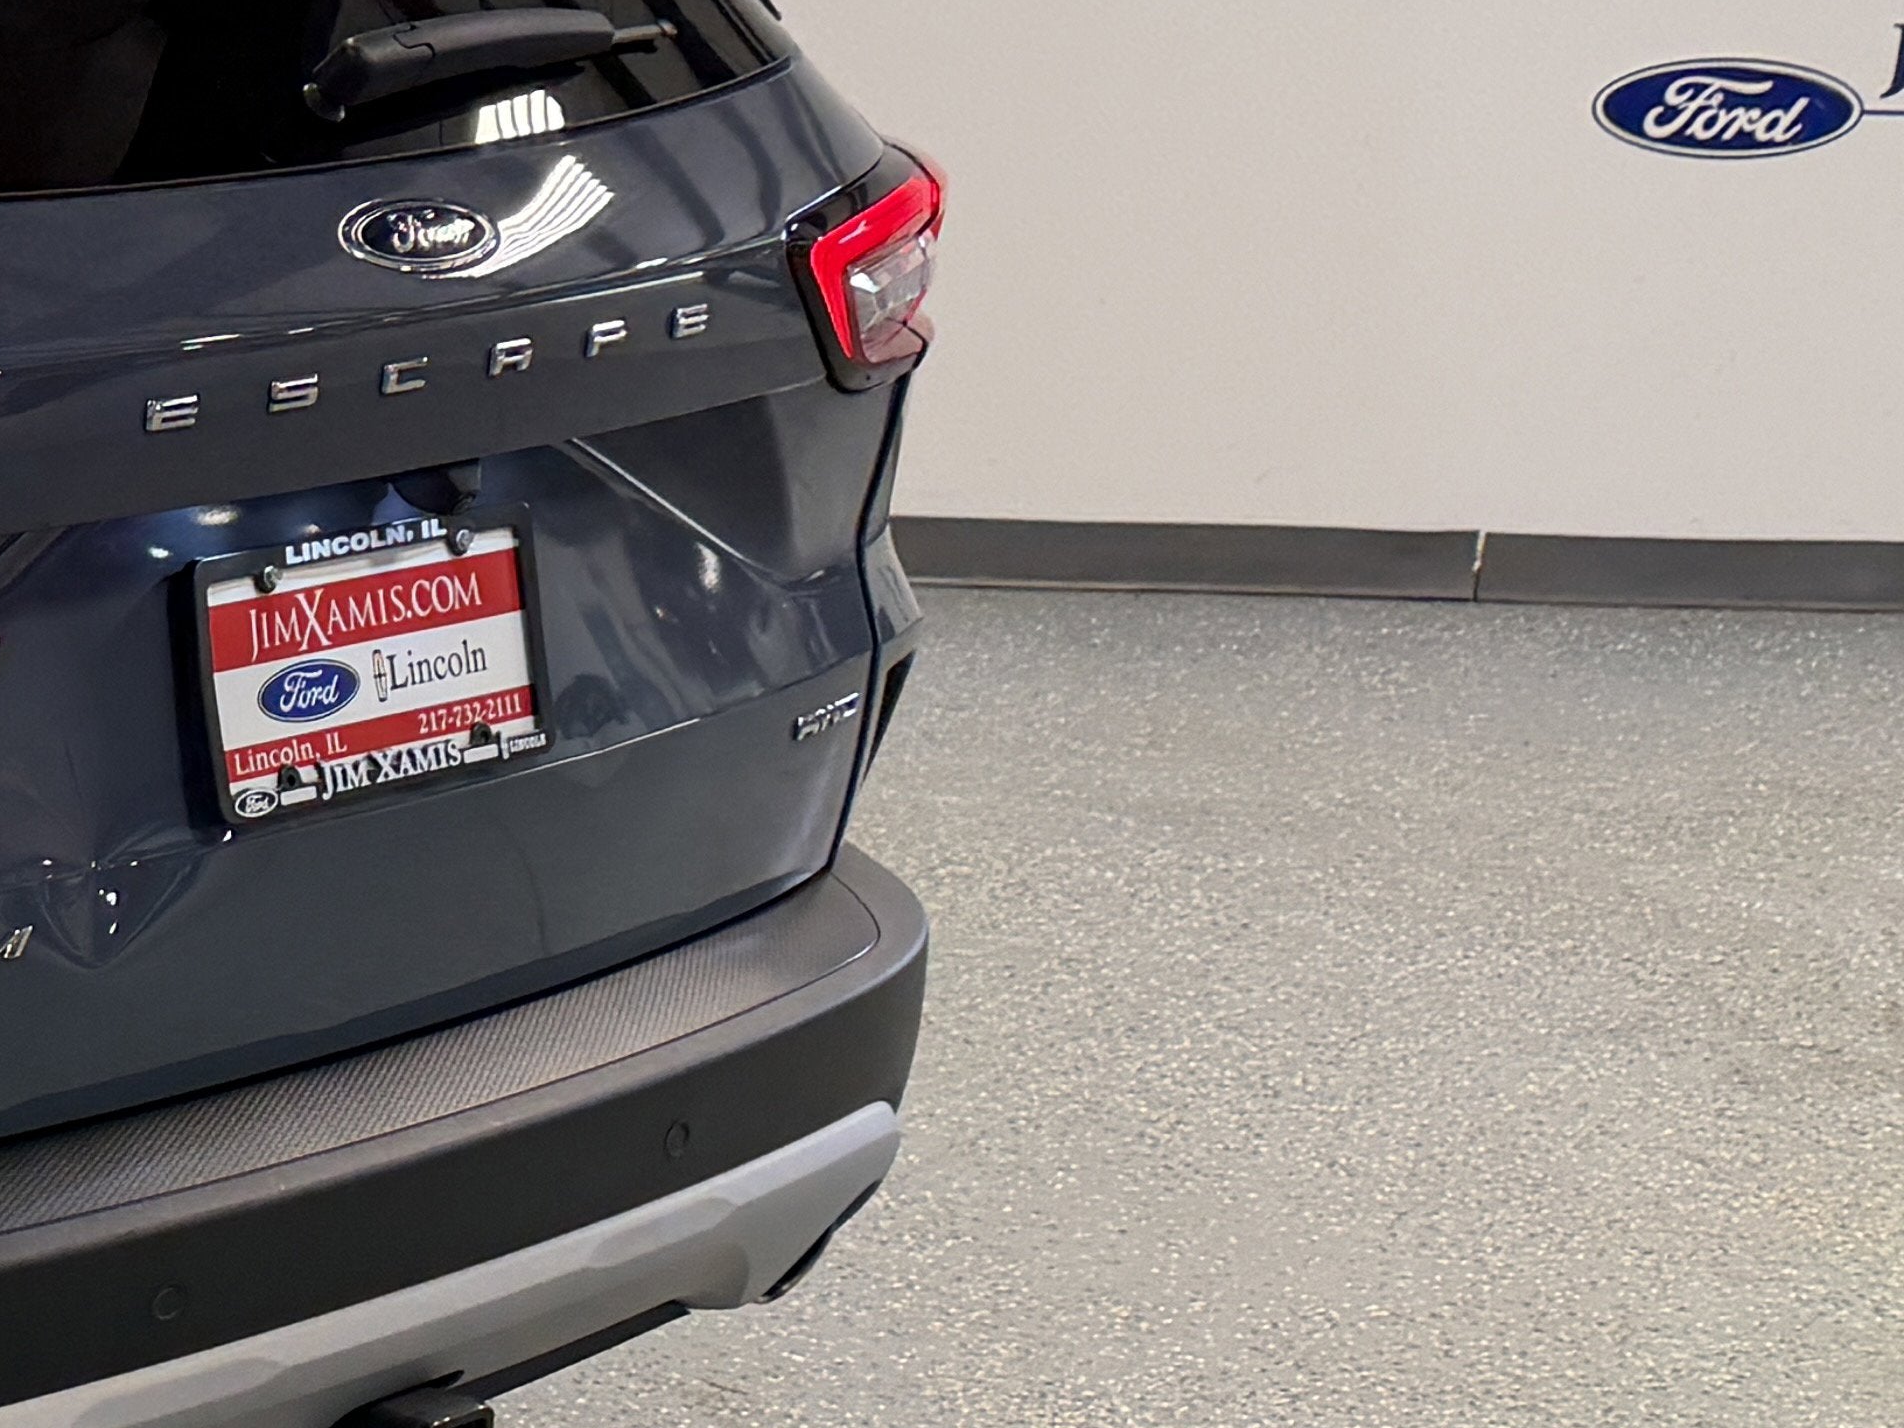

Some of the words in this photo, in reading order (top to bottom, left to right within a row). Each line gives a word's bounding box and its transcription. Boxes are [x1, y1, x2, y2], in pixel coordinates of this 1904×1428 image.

[1643, 74, 1810, 143] Ford
[143, 302, 710, 432] ESCAPE
[284, 524, 414, 565] LINCOLN,
[421, 518, 448, 539] IL
[249, 571, 483, 662] JIMXAMIS.COM
[279, 669, 341, 713] Ford
[386, 639, 488, 691] Lincoln
[418, 692, 522, 735] 217-732-2111
[234, 738, 321, 776] Lincoln,
[325, 731, 348, 755] IL
[321, 759, 370, 801] JIM
[370, 741, 462, 783] XAMIS
